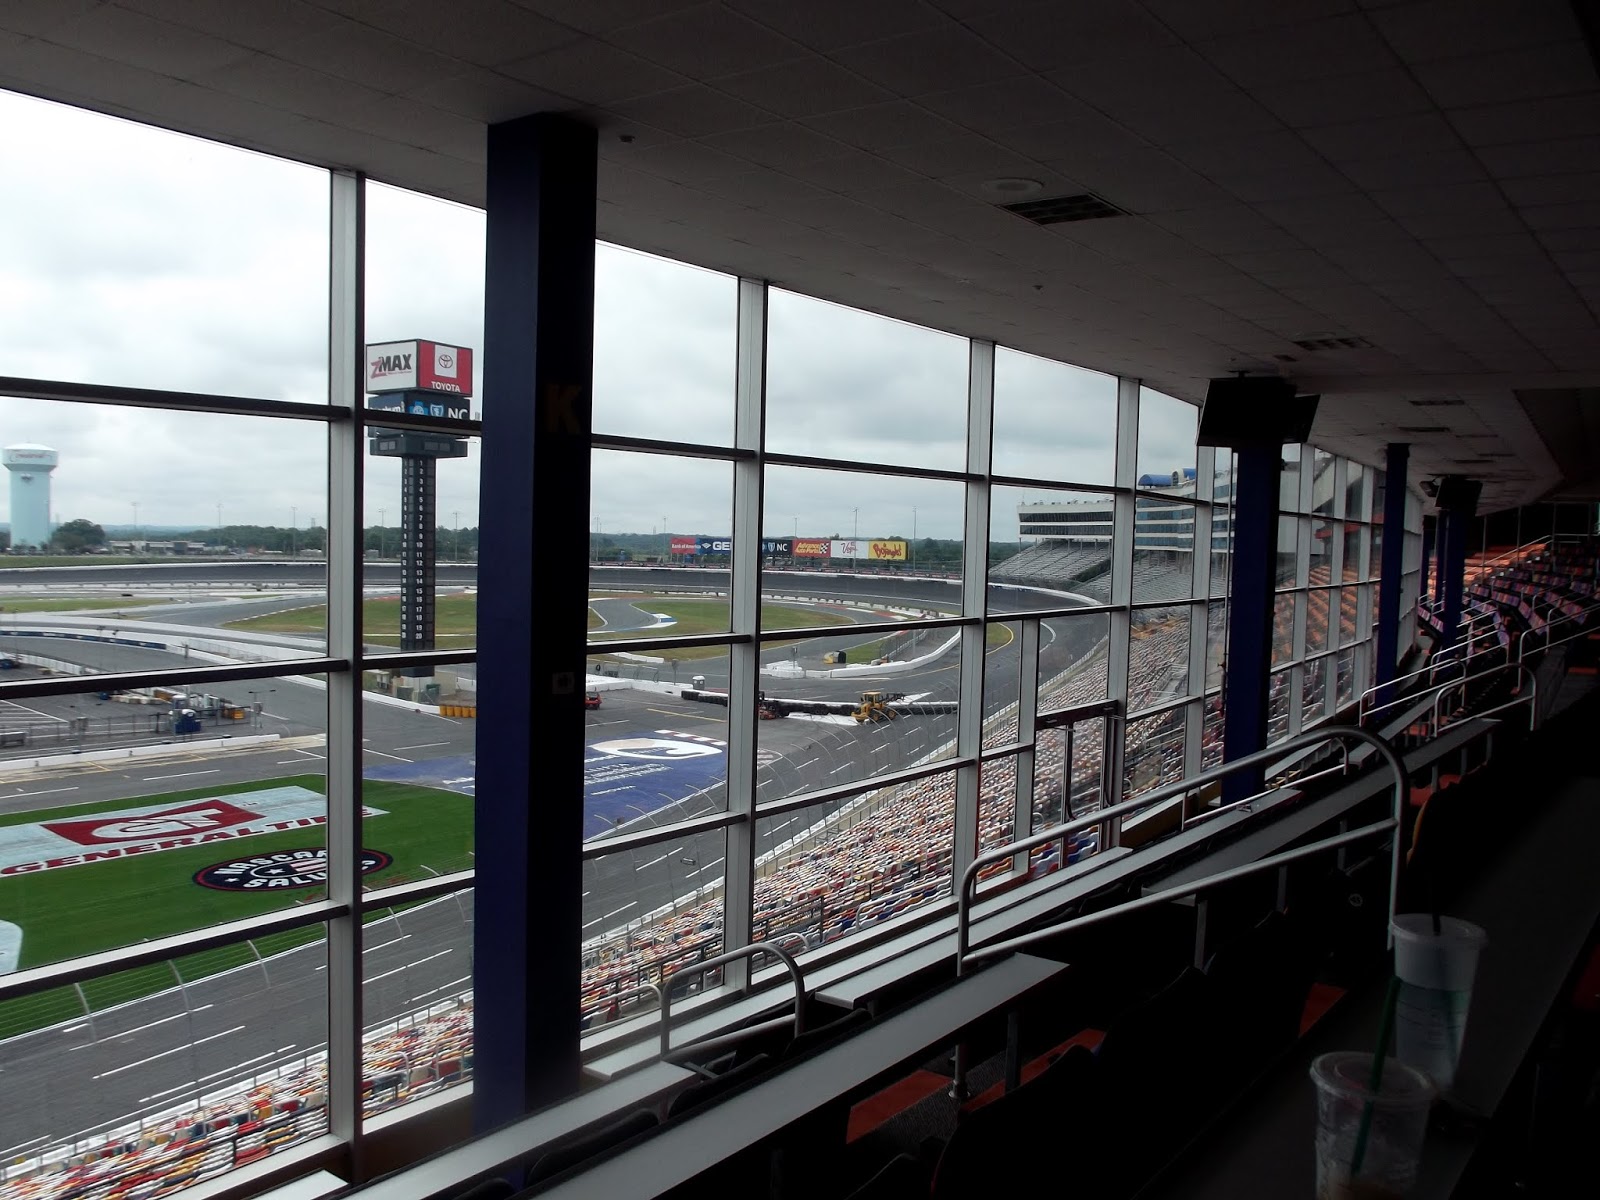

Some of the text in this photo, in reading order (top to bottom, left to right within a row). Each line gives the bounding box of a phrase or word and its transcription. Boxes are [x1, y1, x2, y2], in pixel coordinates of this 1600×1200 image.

[431, 381, 461, 392] TOYOTA
[448, 407, 468, 419] NC
[776, 543, 788, 551] NC
[1, 827, 265, 875] GENERAL
